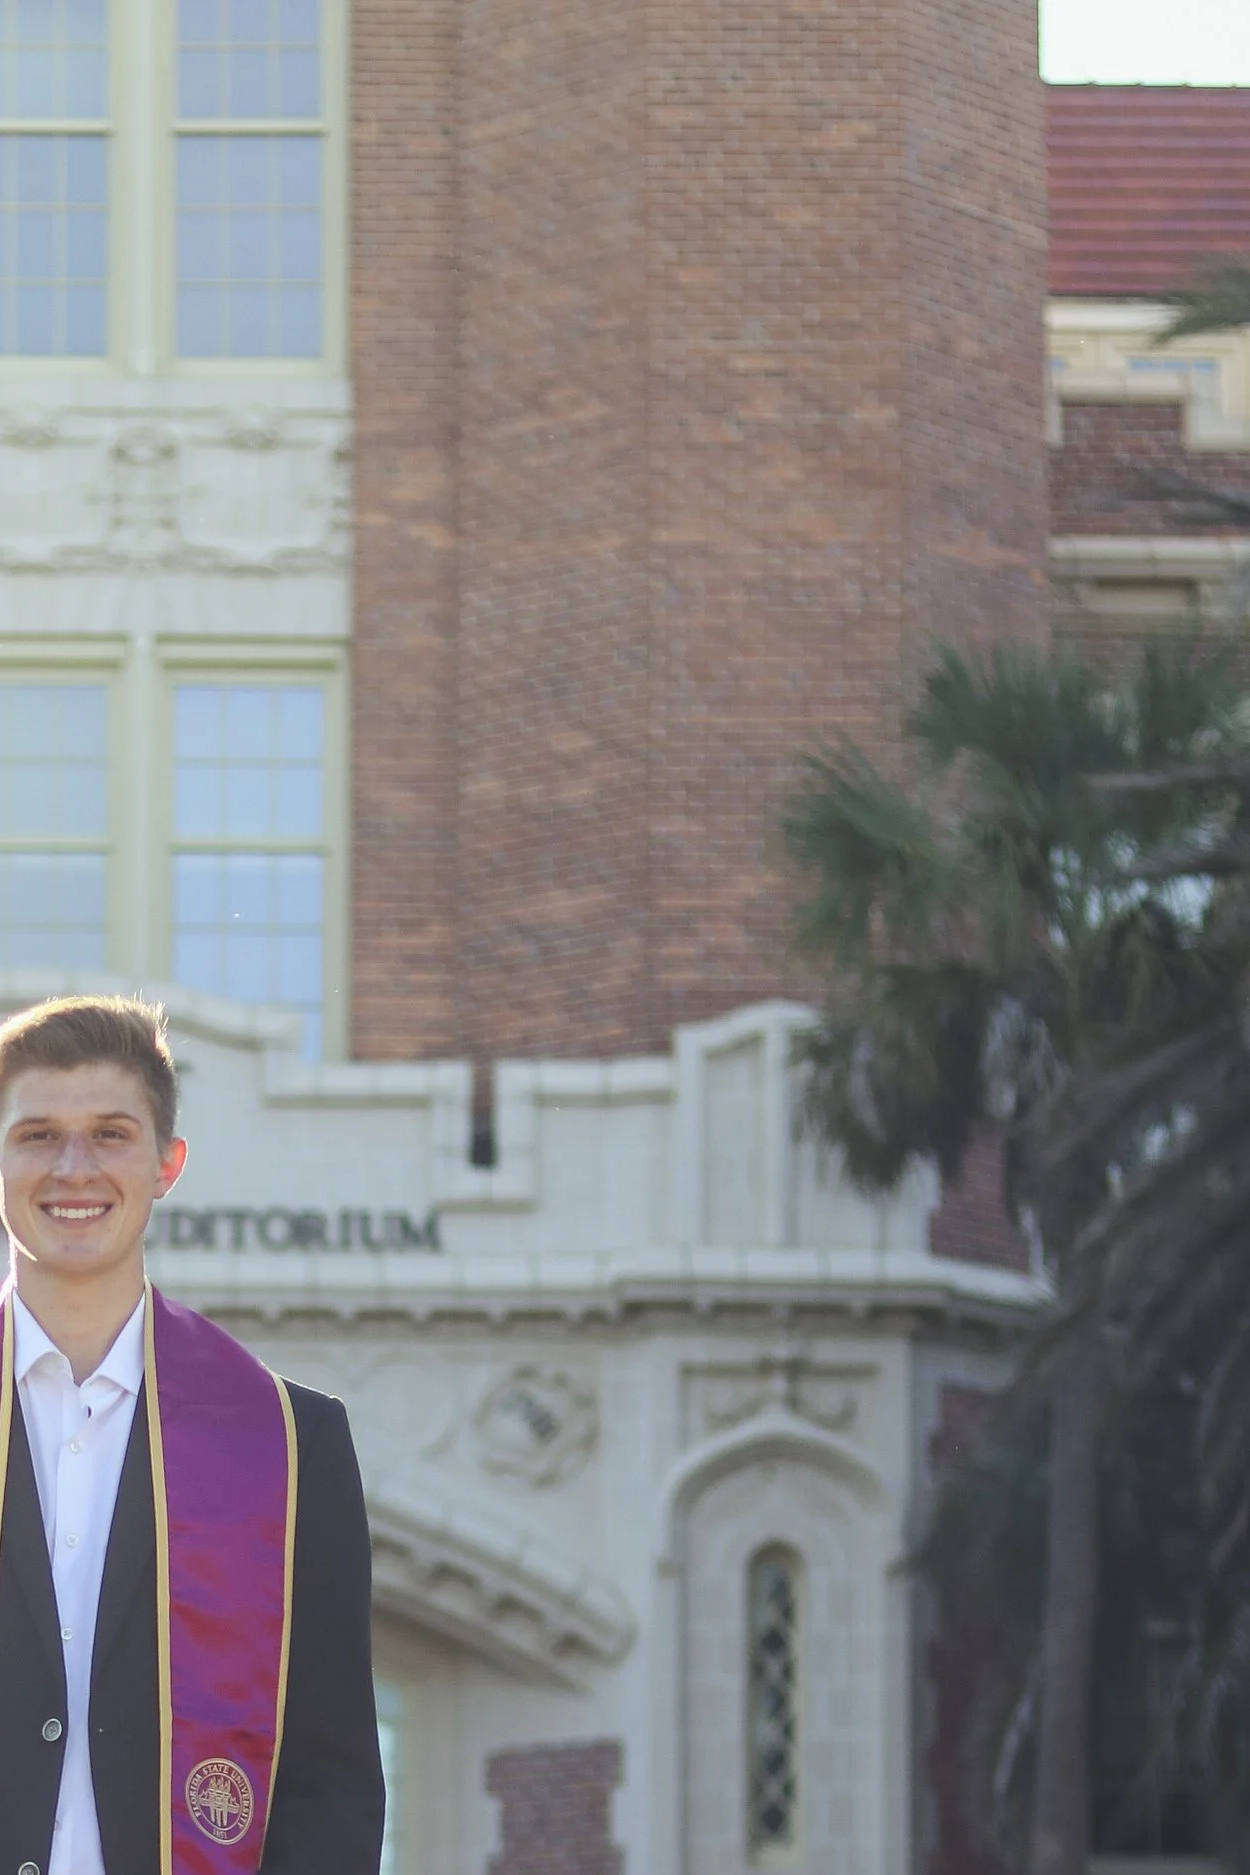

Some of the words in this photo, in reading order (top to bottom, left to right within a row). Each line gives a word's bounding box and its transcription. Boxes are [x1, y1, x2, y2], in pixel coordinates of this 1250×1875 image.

[145, 1205, 445, 1252] DITORIUM
[189, 1773, 203, 1818] FLORIDA
[202, 1764, 230, 1775] STATE
[230, 1770, 251, 1830] UNIVERSITY
